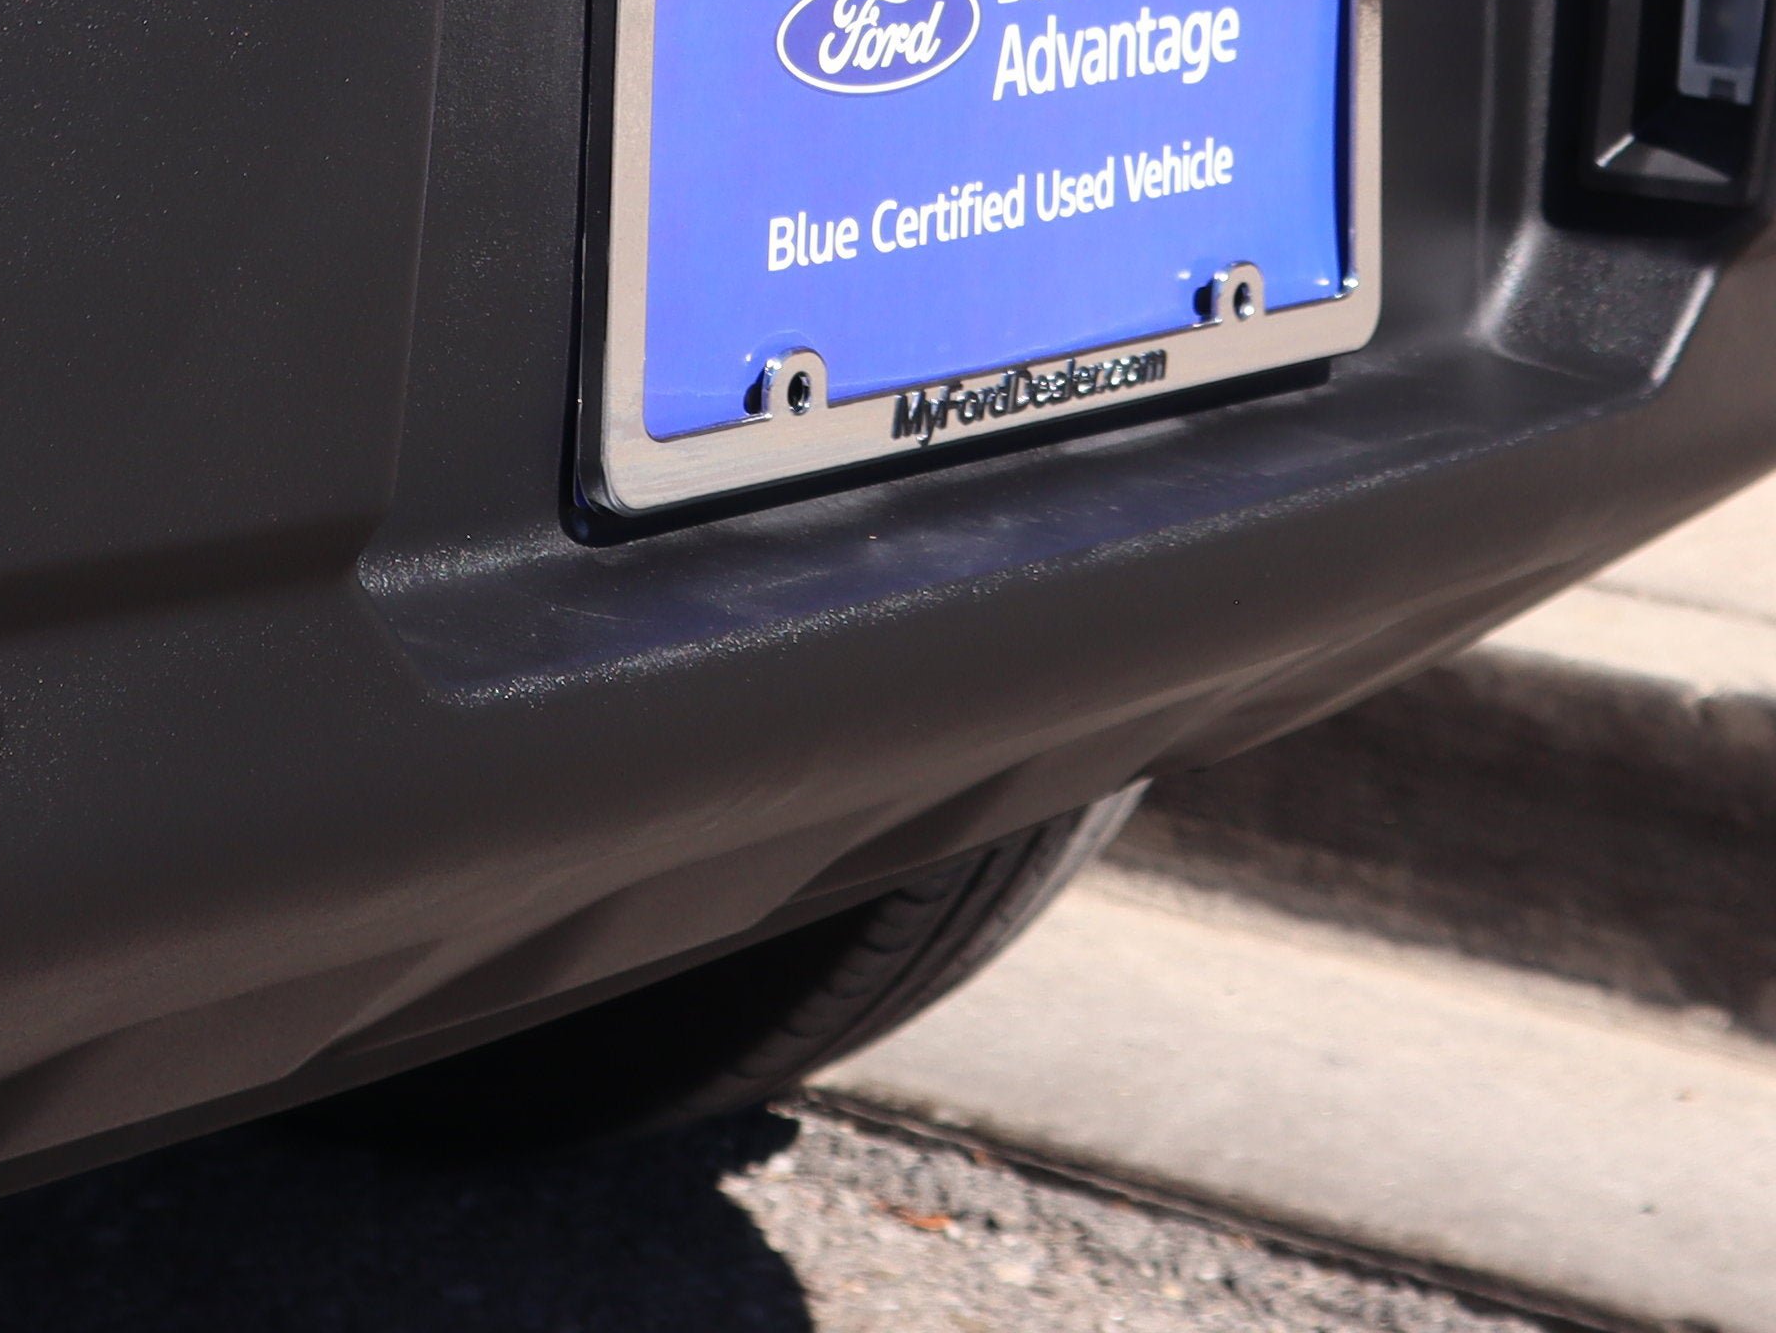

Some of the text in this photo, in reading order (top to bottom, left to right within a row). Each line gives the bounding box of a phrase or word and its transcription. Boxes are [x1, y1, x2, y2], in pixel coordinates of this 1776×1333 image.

[992, 5, 1240, 101] Advantage
[767, 136, 1234, 272] Blue Certified Used Vehicle
[891, 348, 1166, 446] MyFordDealer.com
